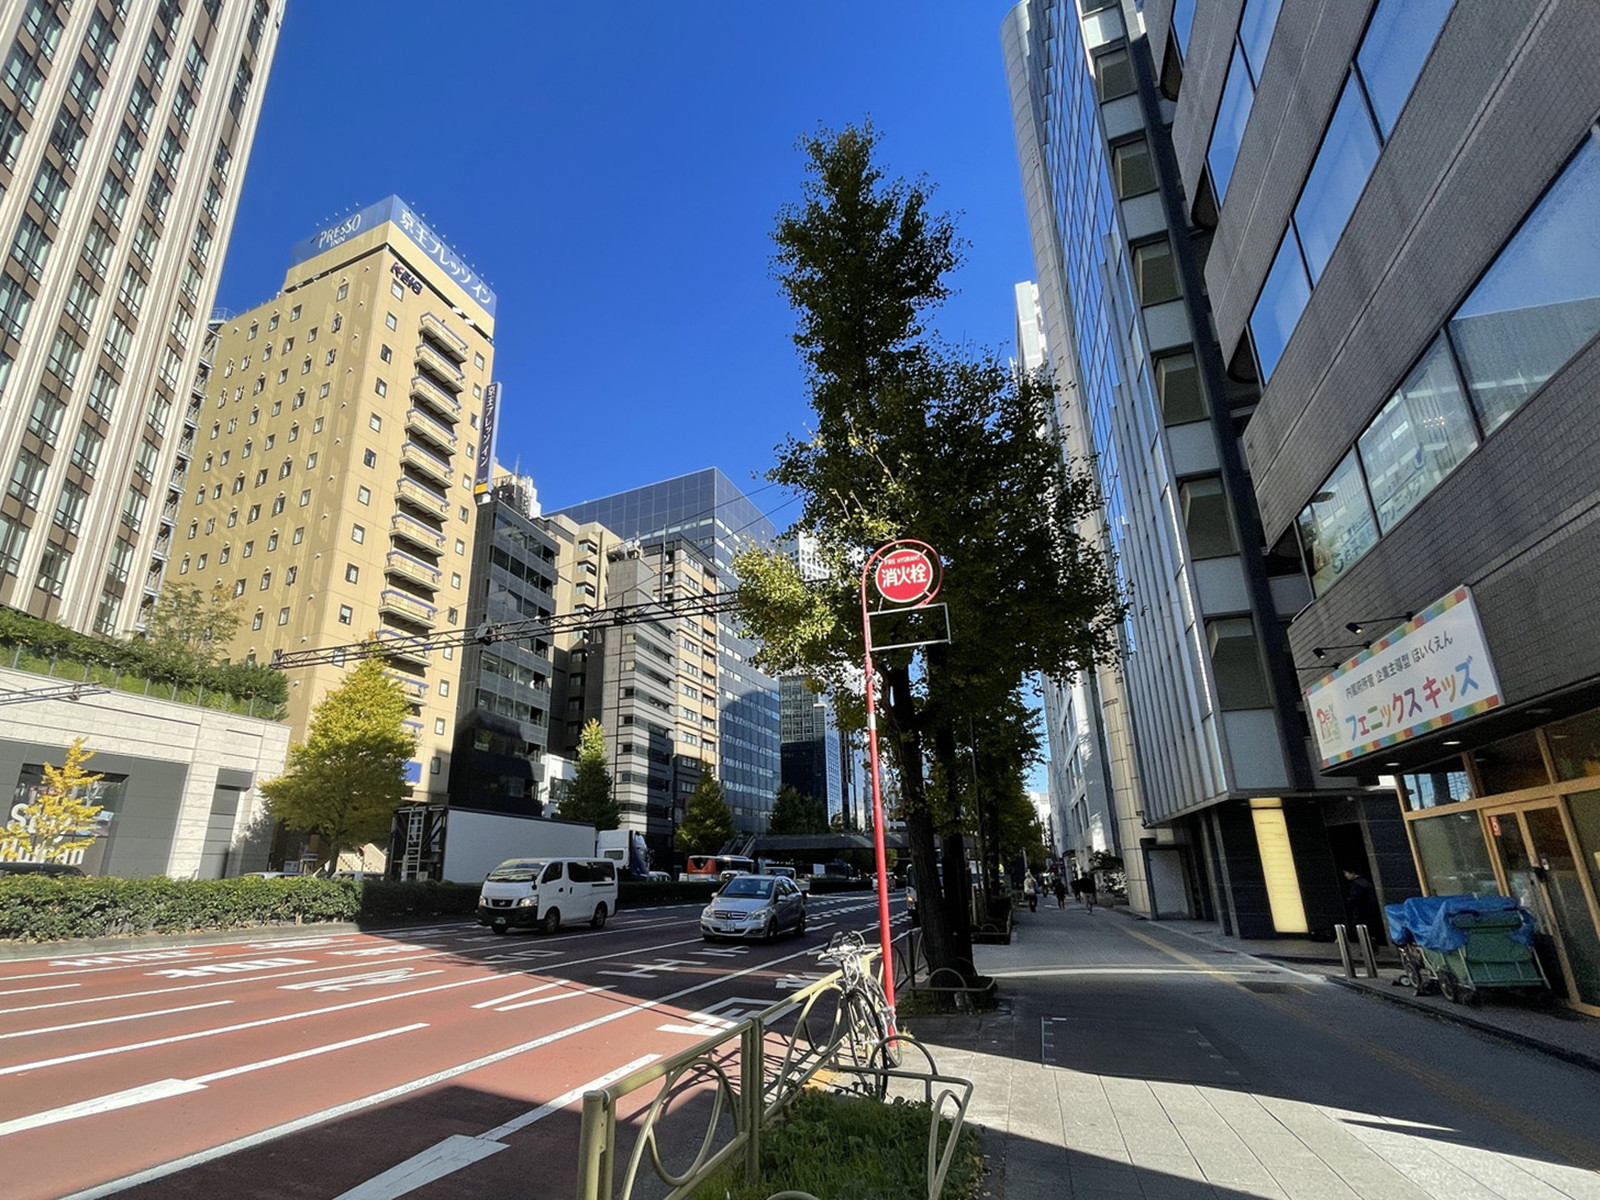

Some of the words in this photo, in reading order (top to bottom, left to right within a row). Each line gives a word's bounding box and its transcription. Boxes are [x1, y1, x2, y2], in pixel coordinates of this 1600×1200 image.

[318, 213, 362, 248] PRESSO
[401, 208, 492, 304] 京王プレッソイン
[881, 563, 928, 588] 消火栓
[1412, 631, 1453, 663] ほいくえん
